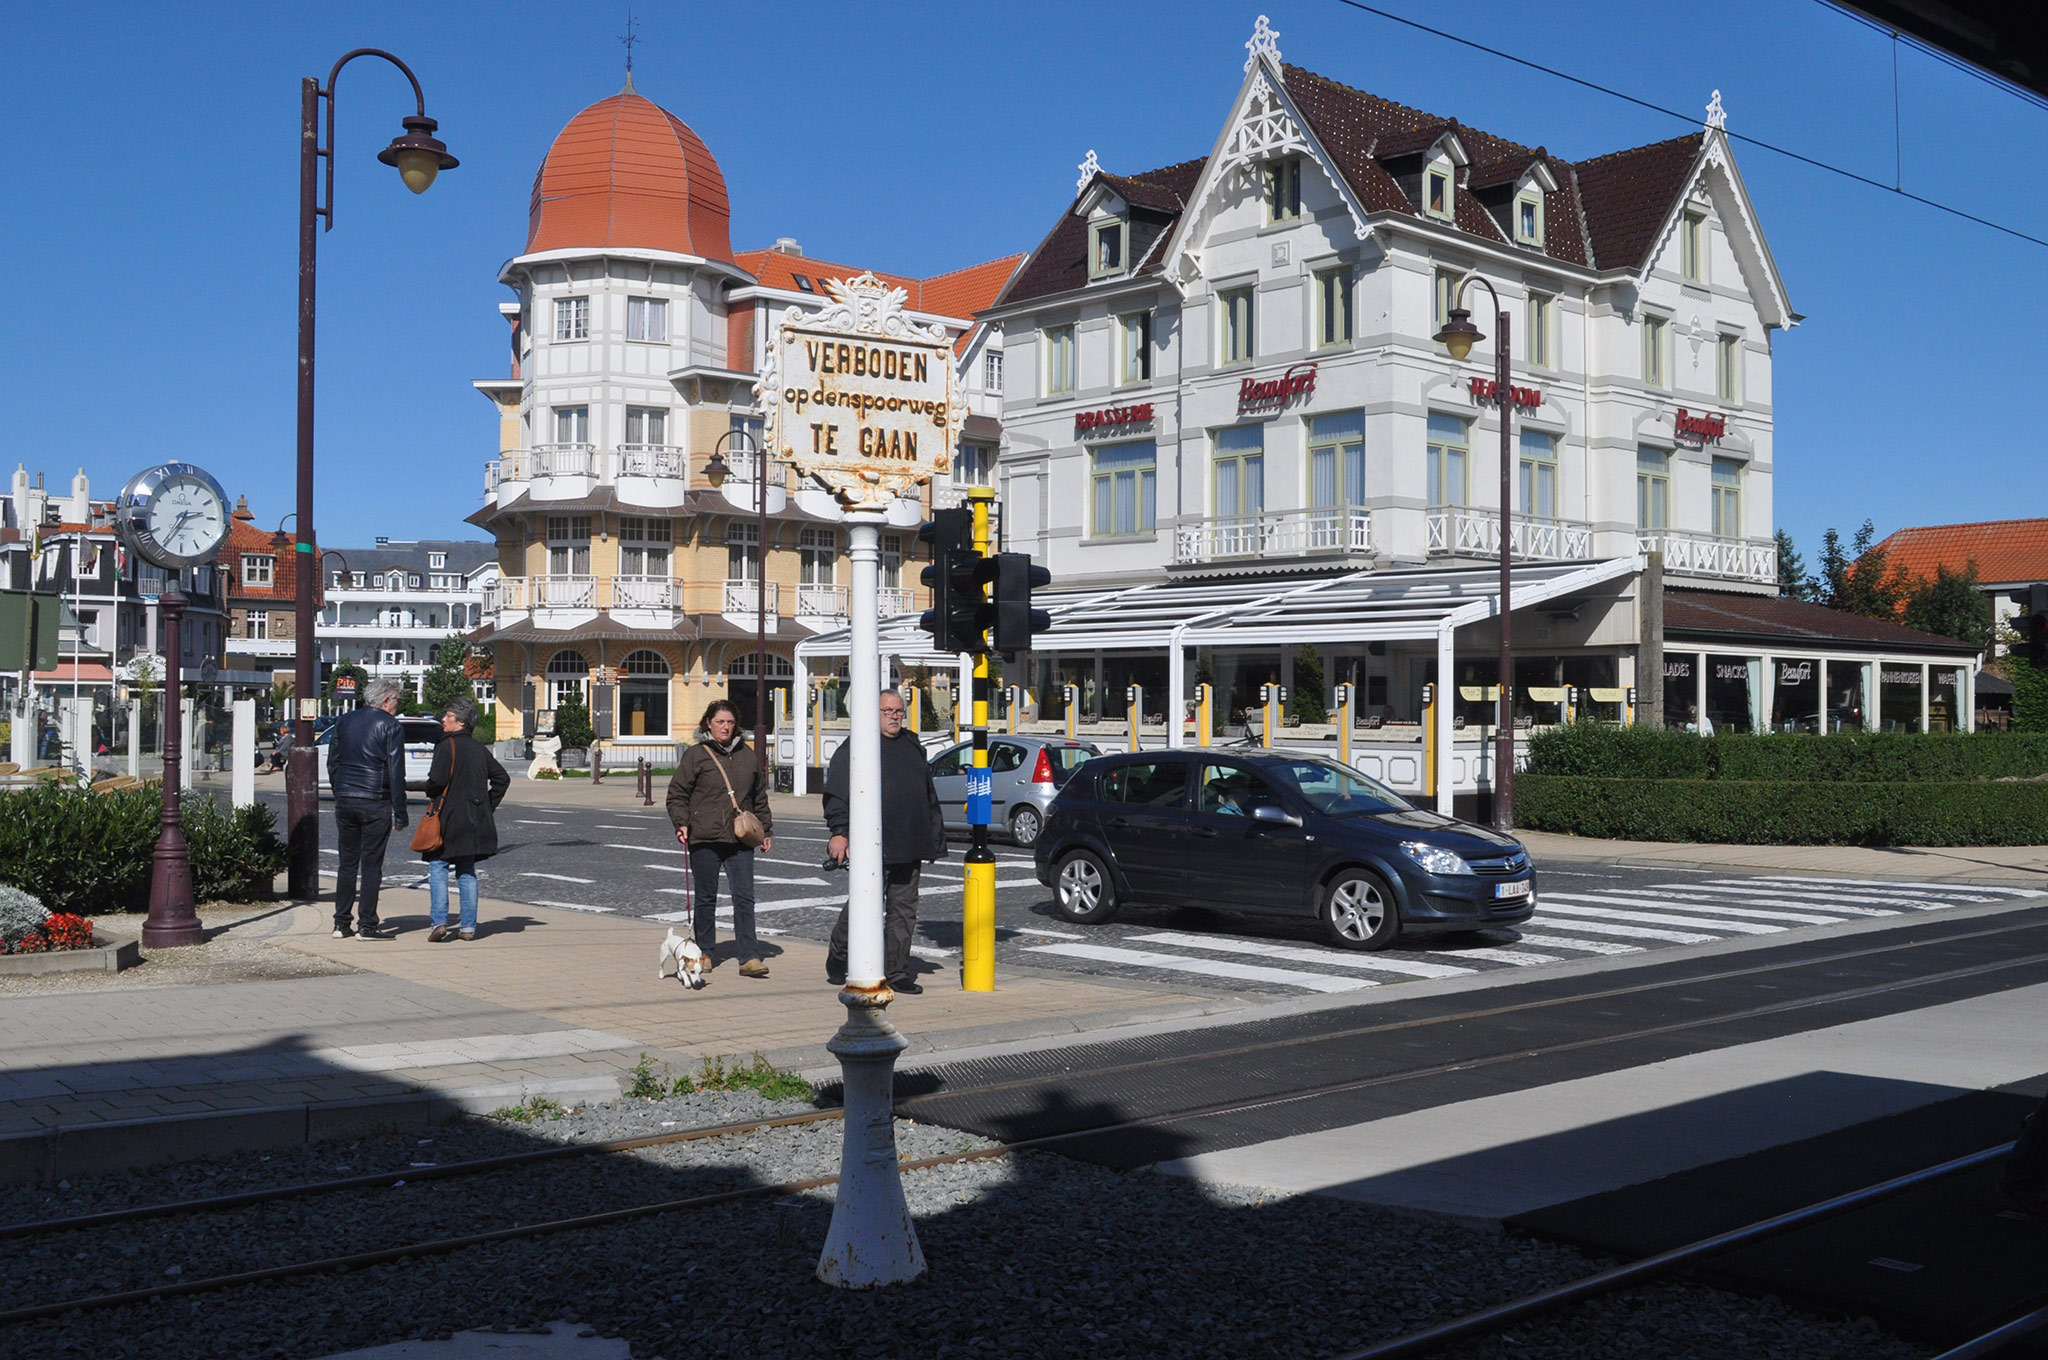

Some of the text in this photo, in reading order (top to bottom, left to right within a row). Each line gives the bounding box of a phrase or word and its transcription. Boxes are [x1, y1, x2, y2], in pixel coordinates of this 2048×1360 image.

[806, 340, 927, 383] VERBODEN
[1238, 362, 1318, 411] Beaufort
[784, 387, 809, 414] op
[1075, 402, 1156, 429] BRASSERIE
[810, 422, 918, 461] TE GAAN
[1662, 662, 1690, 677] LADES
[1716, 664, 1747, 679] SNACKS
